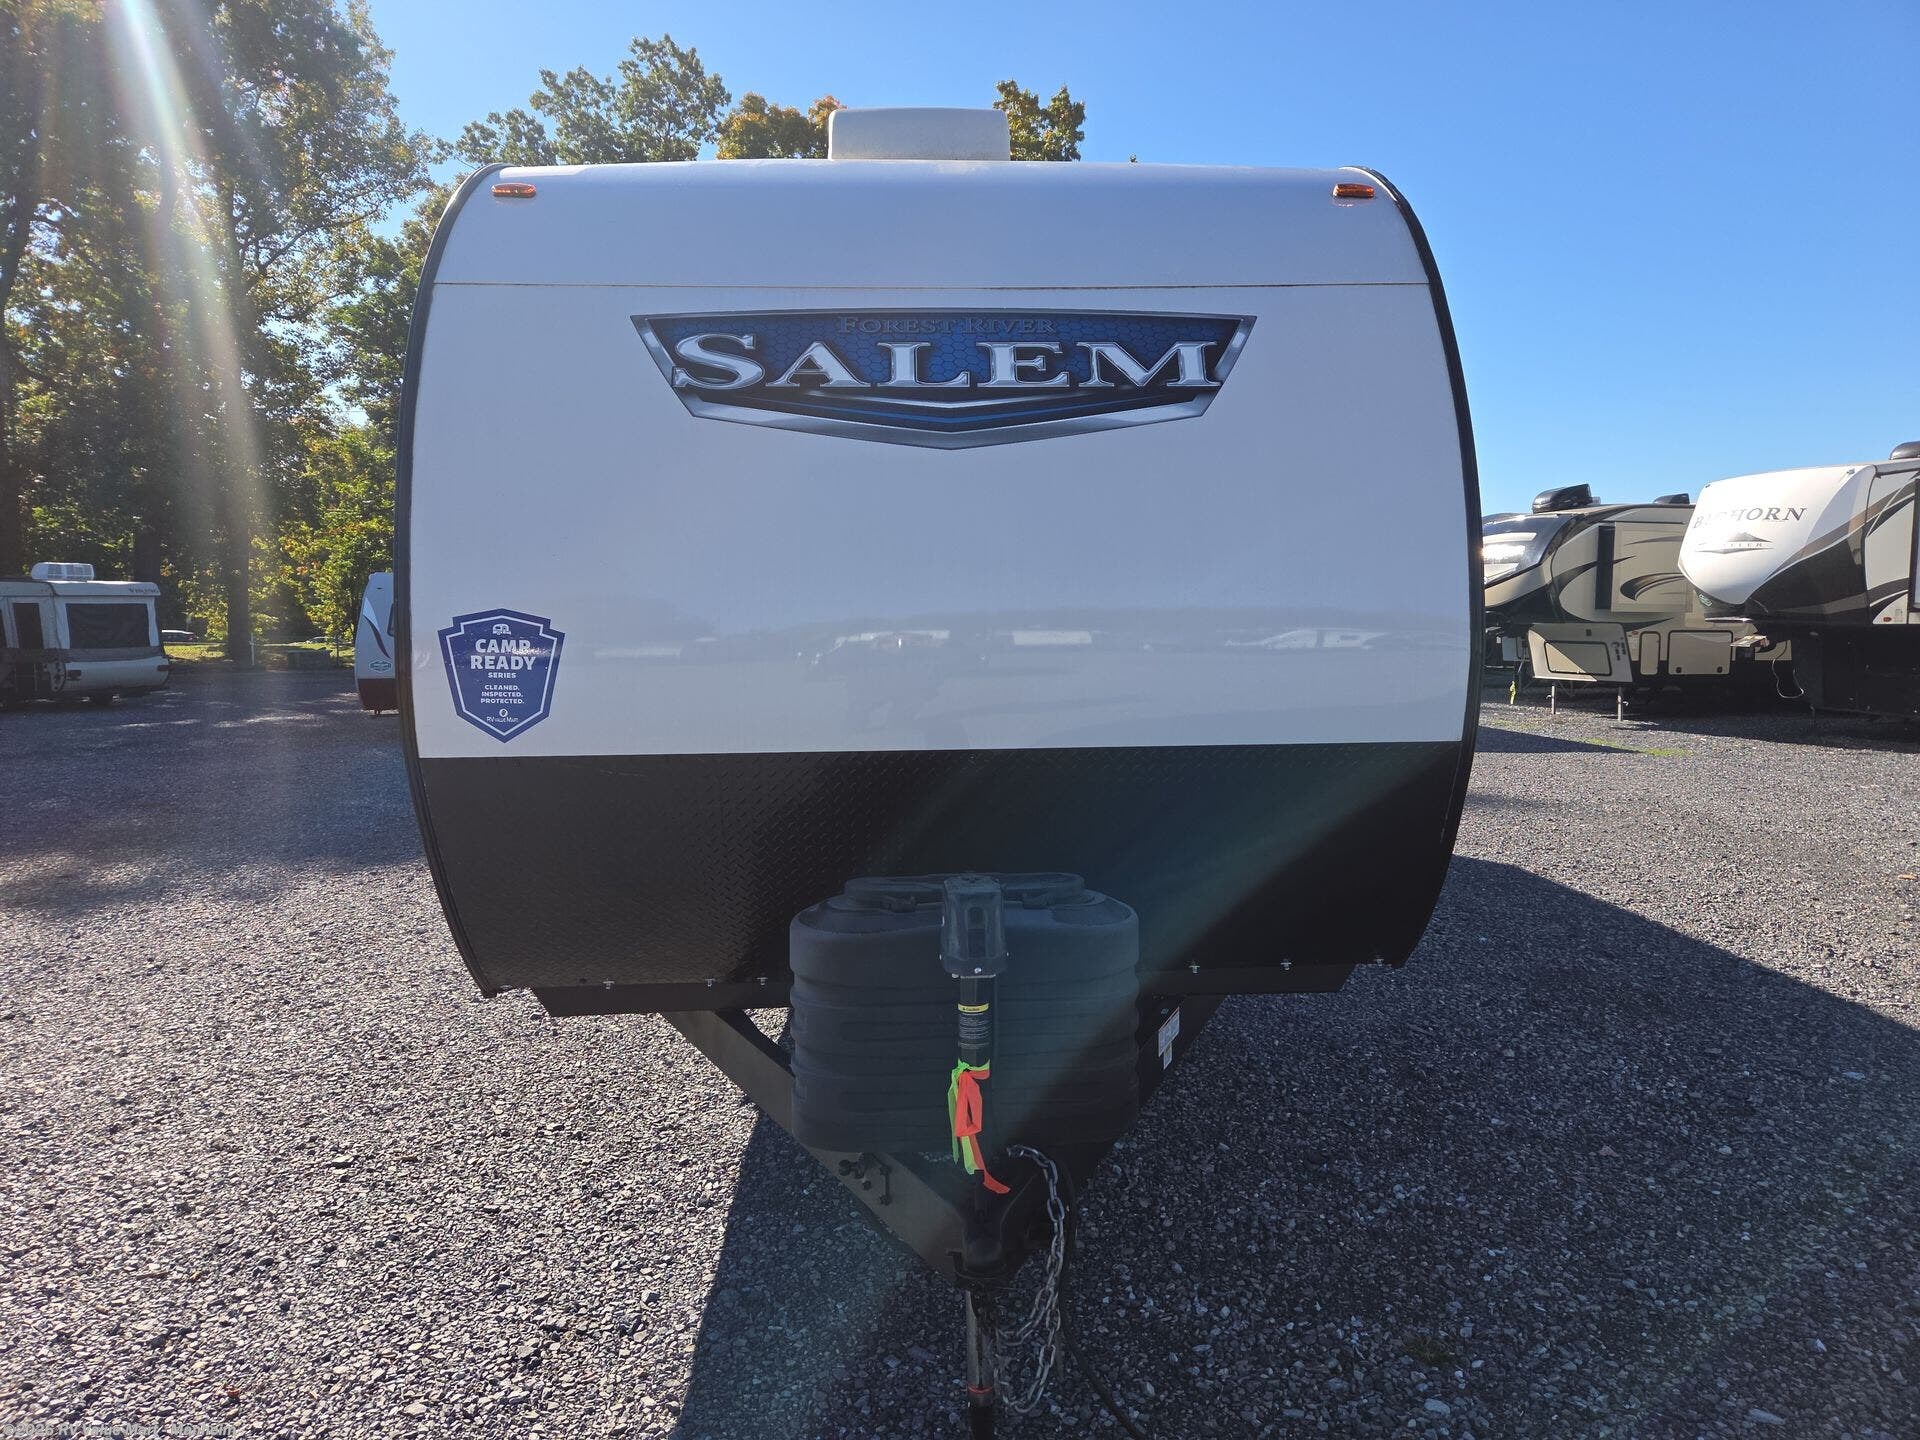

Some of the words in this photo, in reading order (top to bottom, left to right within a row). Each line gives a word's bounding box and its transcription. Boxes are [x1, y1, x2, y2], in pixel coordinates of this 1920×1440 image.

[837, 316, 956, 334] FOREST
[960, 316, 1057, 334] RIVER
[672, 333, 1222, 389] SALEM
[475, 639, 531, 653] CAMP
[470, 655, 536, 670] READY
